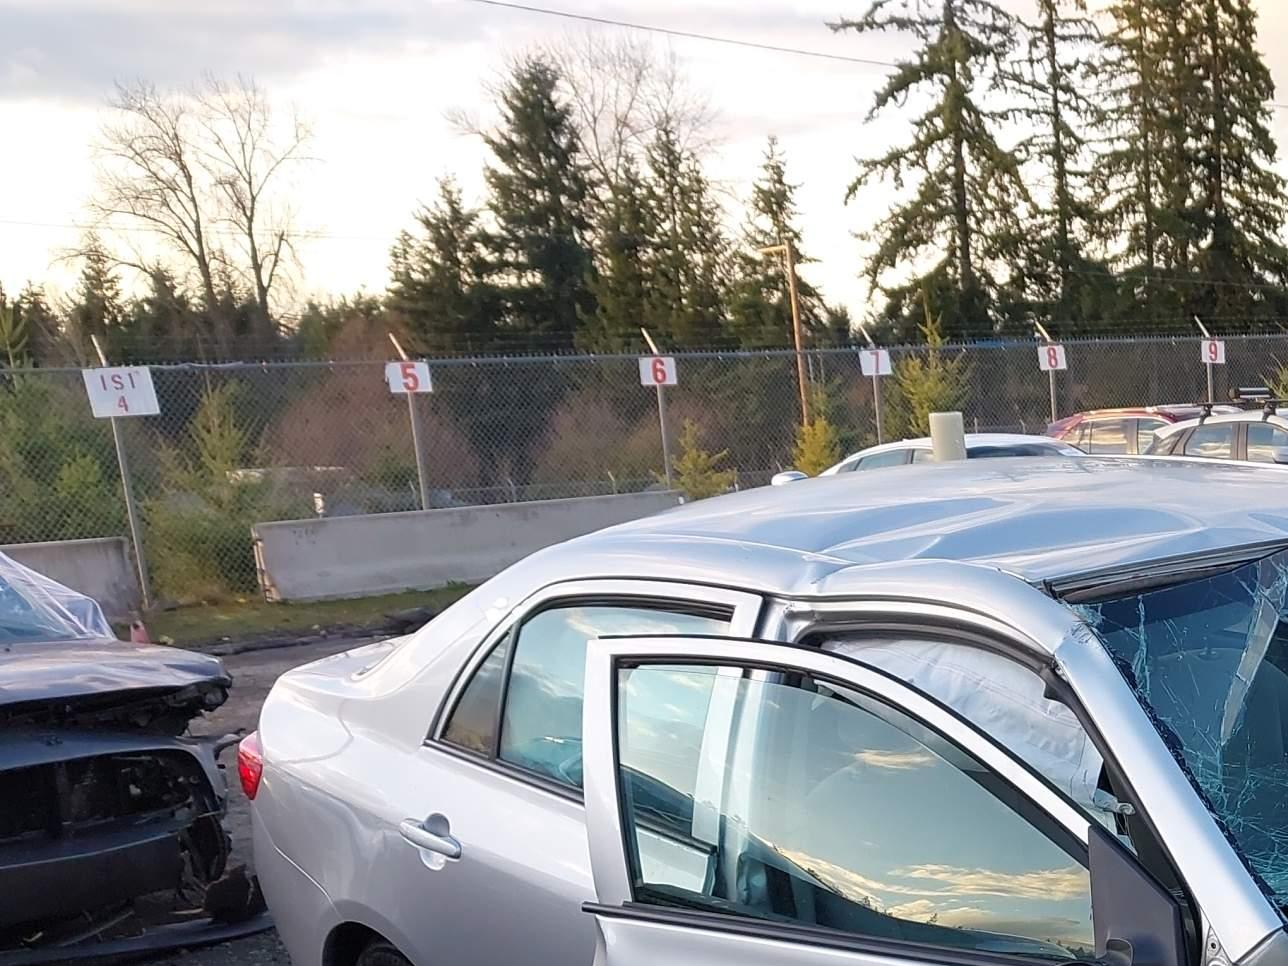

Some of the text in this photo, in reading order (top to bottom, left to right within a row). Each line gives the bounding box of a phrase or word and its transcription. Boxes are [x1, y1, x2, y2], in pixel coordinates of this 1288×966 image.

[870, 351, 880, 374] 7
[1047, 346, 1058, 369] 8
[1208, 342, 1218, 362] 9
[400, 363, 419, 391] 5
[652, 358, 667, 384] 6
